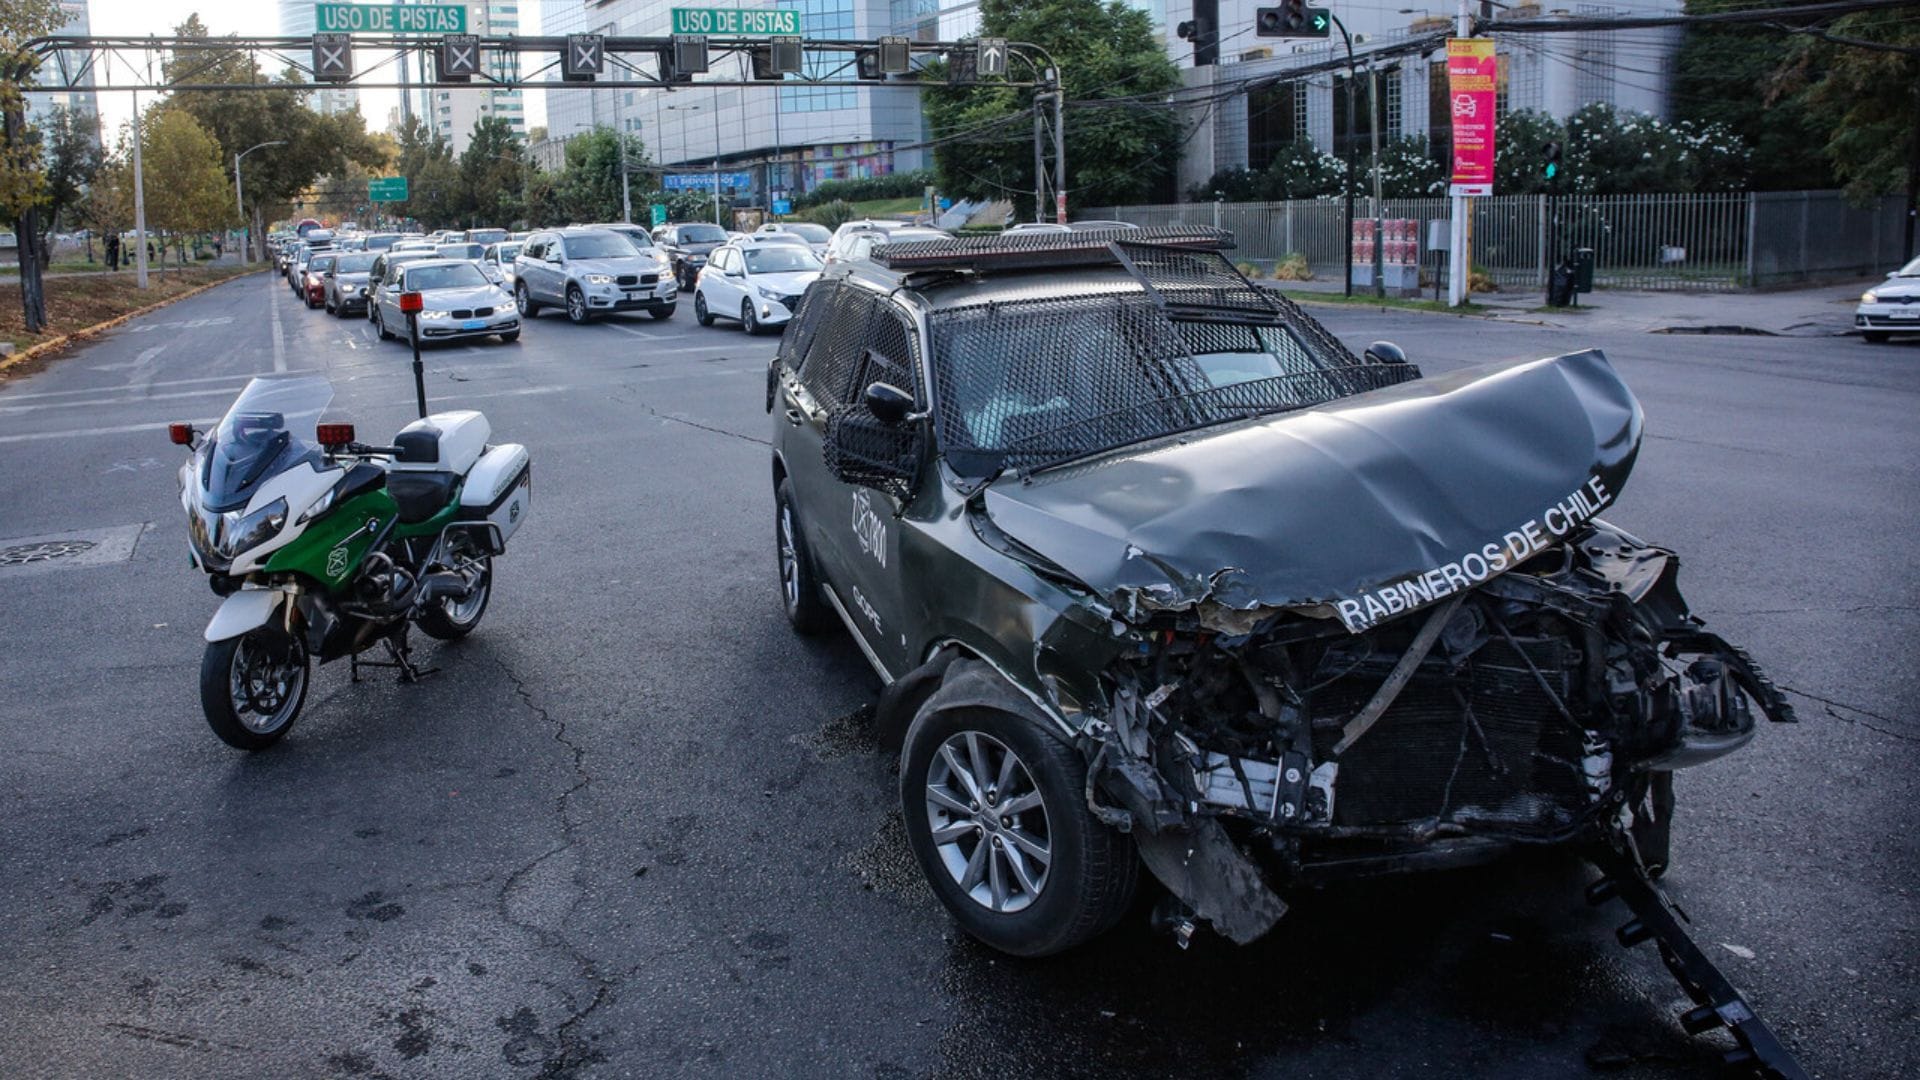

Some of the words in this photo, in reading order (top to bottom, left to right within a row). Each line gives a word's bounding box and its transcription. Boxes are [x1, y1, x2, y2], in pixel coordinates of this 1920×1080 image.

[324, 7, 362, 29] USO
[369, 7, 394, 30] DE
[401, 8, 460, 30] PISTAS
[678, 10, 711, 32] USO
[717, 11, 737, 32] DE
[743, 12, 795, 33] PISTAS
[1338, 542, 1509, 634] RABINEROS
[1503, 520, 1549, 561] DE
[1544, 475, 1612, 535] CHILE
